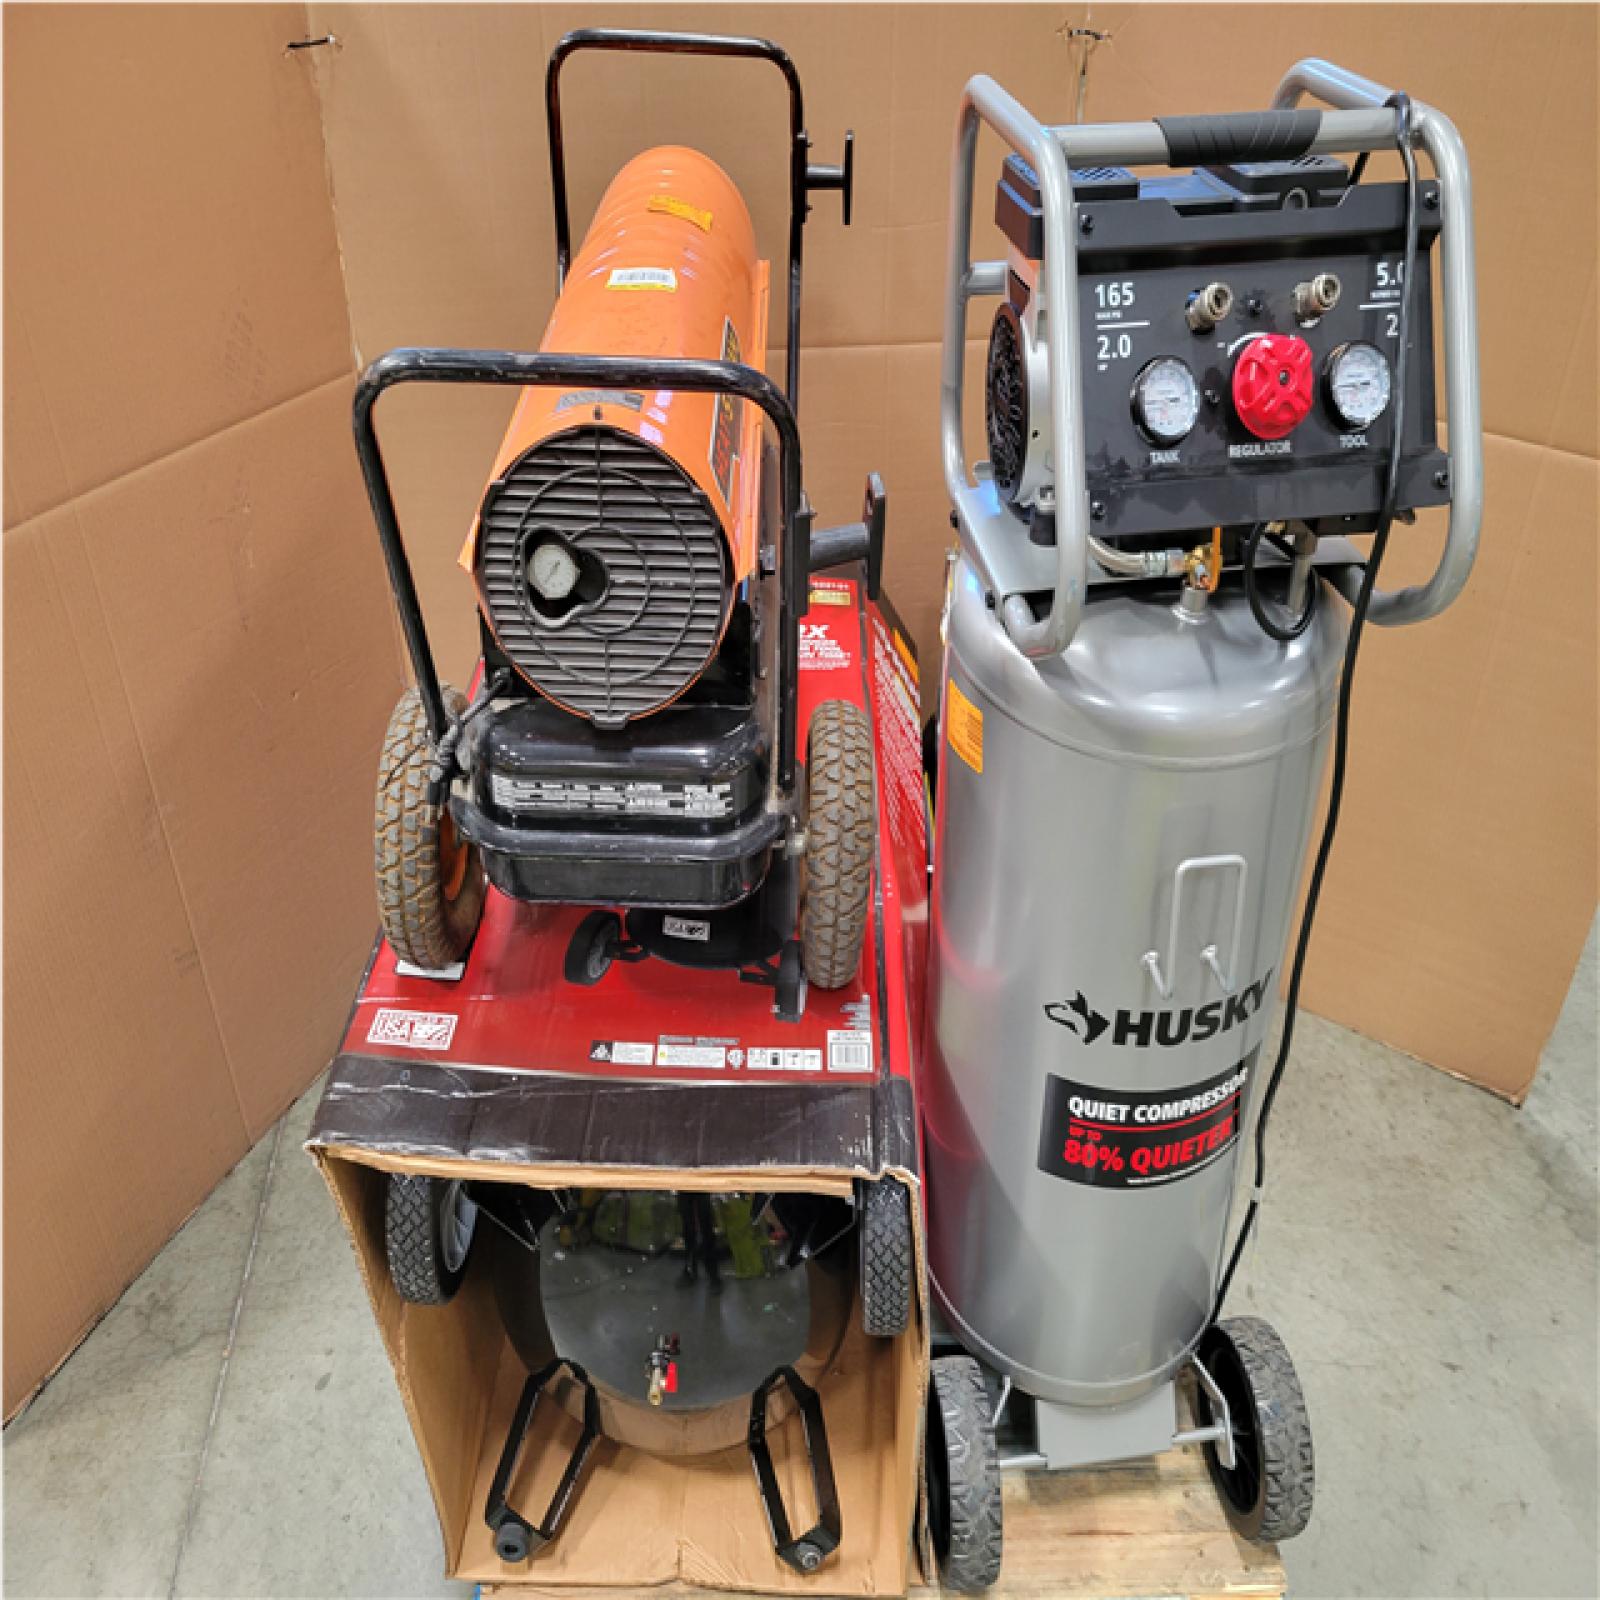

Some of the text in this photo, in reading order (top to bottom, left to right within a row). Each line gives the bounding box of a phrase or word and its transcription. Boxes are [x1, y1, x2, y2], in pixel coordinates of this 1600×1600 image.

[1095, 282, 1135, 308] 165
[1385, 312, 1398, 338] 2
[1097, 333, 1131, 360] 2.0
[1228, 440, 1291, 458] REGULATOR
[1339, 434, 1368, 448] TOOL
[1149, 450, 1180, 465] TANK
[1112, 966, 1274, 1047] HUSKY
[1068, 1066, 1248, 1122] QUIET COMPRESSOR
[1063, 1139, 1124, 1171] 80%
[1129, 1116, 1233, 1174] QUIETER
